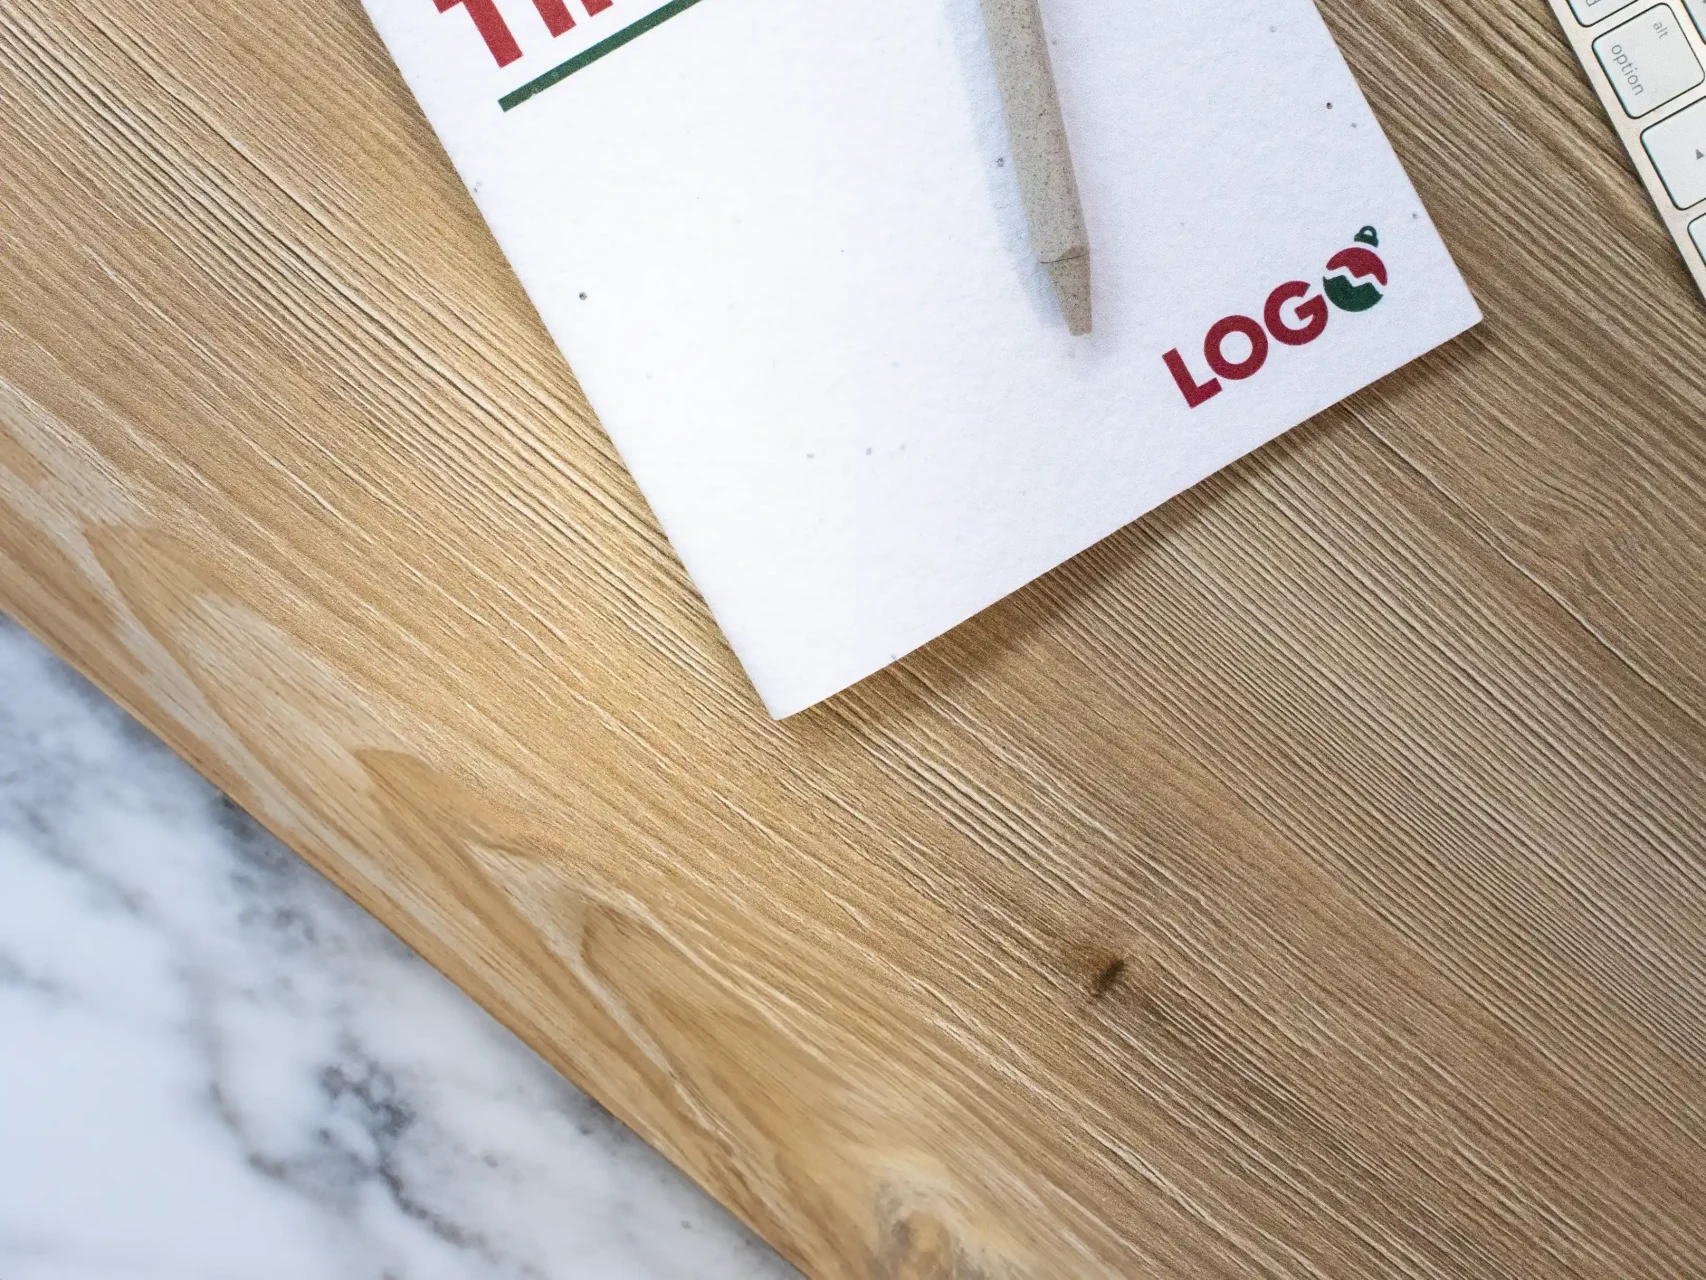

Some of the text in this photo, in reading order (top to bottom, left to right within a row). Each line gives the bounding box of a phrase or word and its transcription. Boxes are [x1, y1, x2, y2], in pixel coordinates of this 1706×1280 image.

[1652, 21, 1669, 40] alt
[1611, 43, 1645, 97] option
[1162, 246, 1387, 408] LOGO
